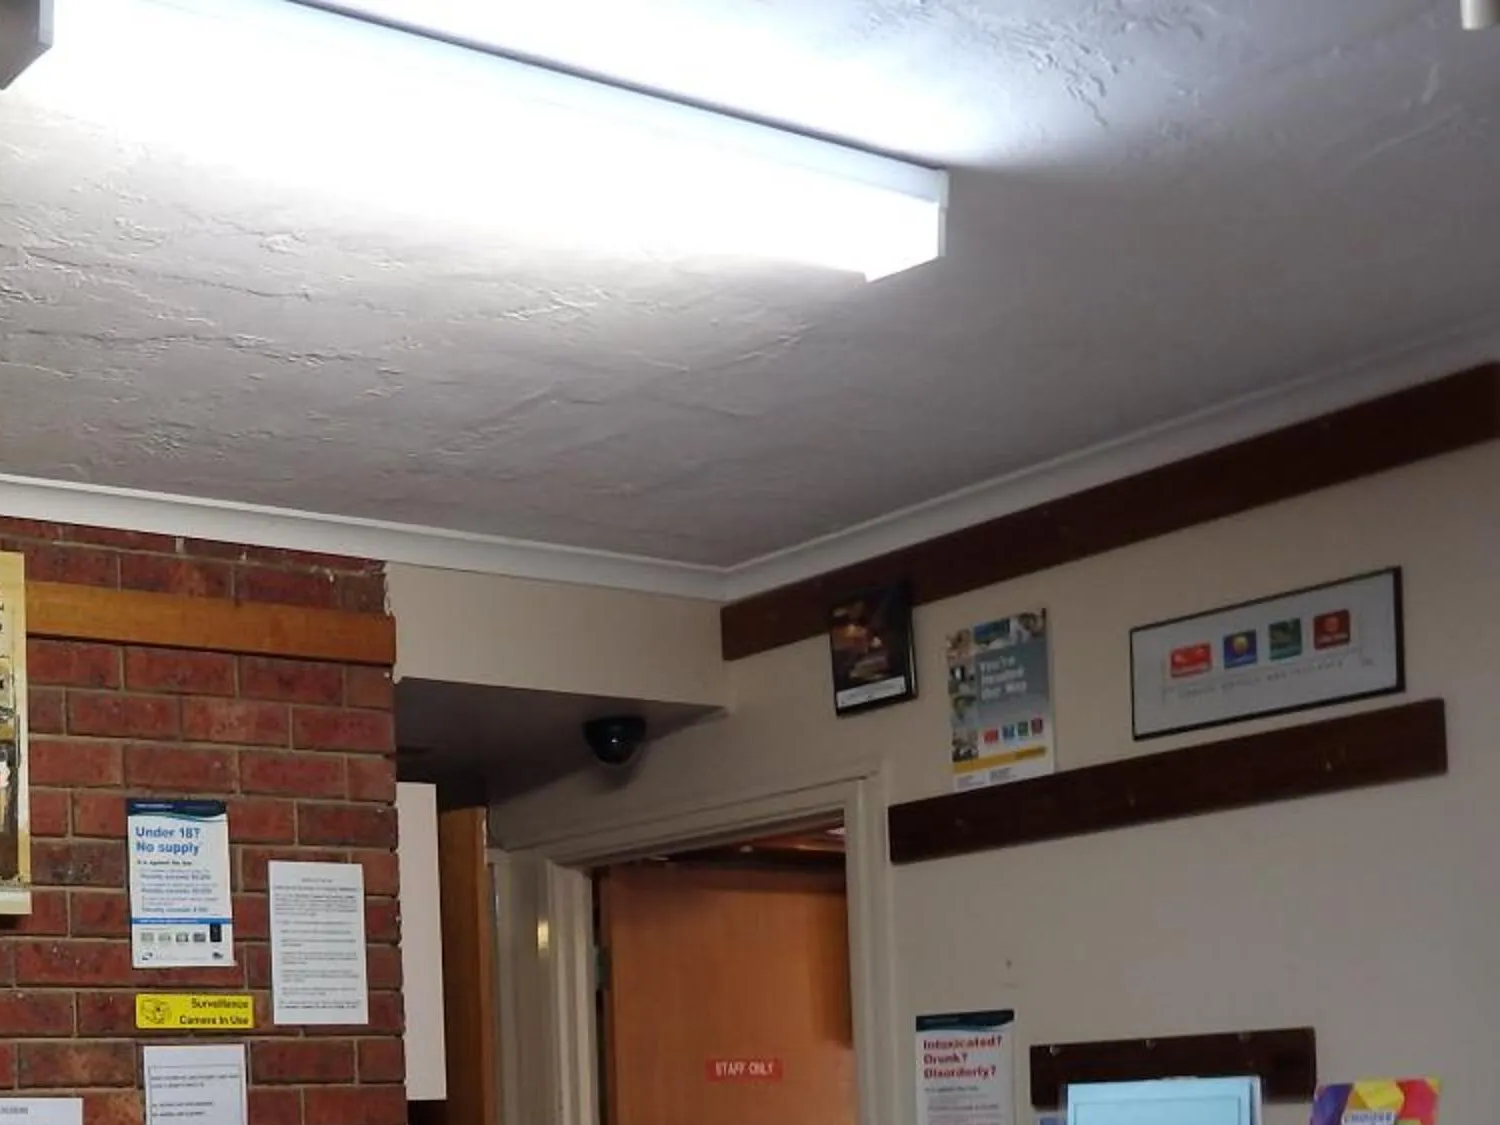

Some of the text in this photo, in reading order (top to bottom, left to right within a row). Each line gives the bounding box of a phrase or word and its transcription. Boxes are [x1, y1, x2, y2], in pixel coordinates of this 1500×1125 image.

[135, 826, 201, 839] Under 18?
[136, 842, 199, 856] No supply
[191, 997, 249, 1009] Surveillance
[179, 1015, 219, 1025] Camera
[230, 1015, 249, 1025] Use
[923, 1034, 1003, 1050] Intoxicated?
[923, 1052, 968, 1065] Drunk?
[715, 1061, 773, 1077] STAFF ONLY
[923, 1064, 997, 1080] Disorderly?
